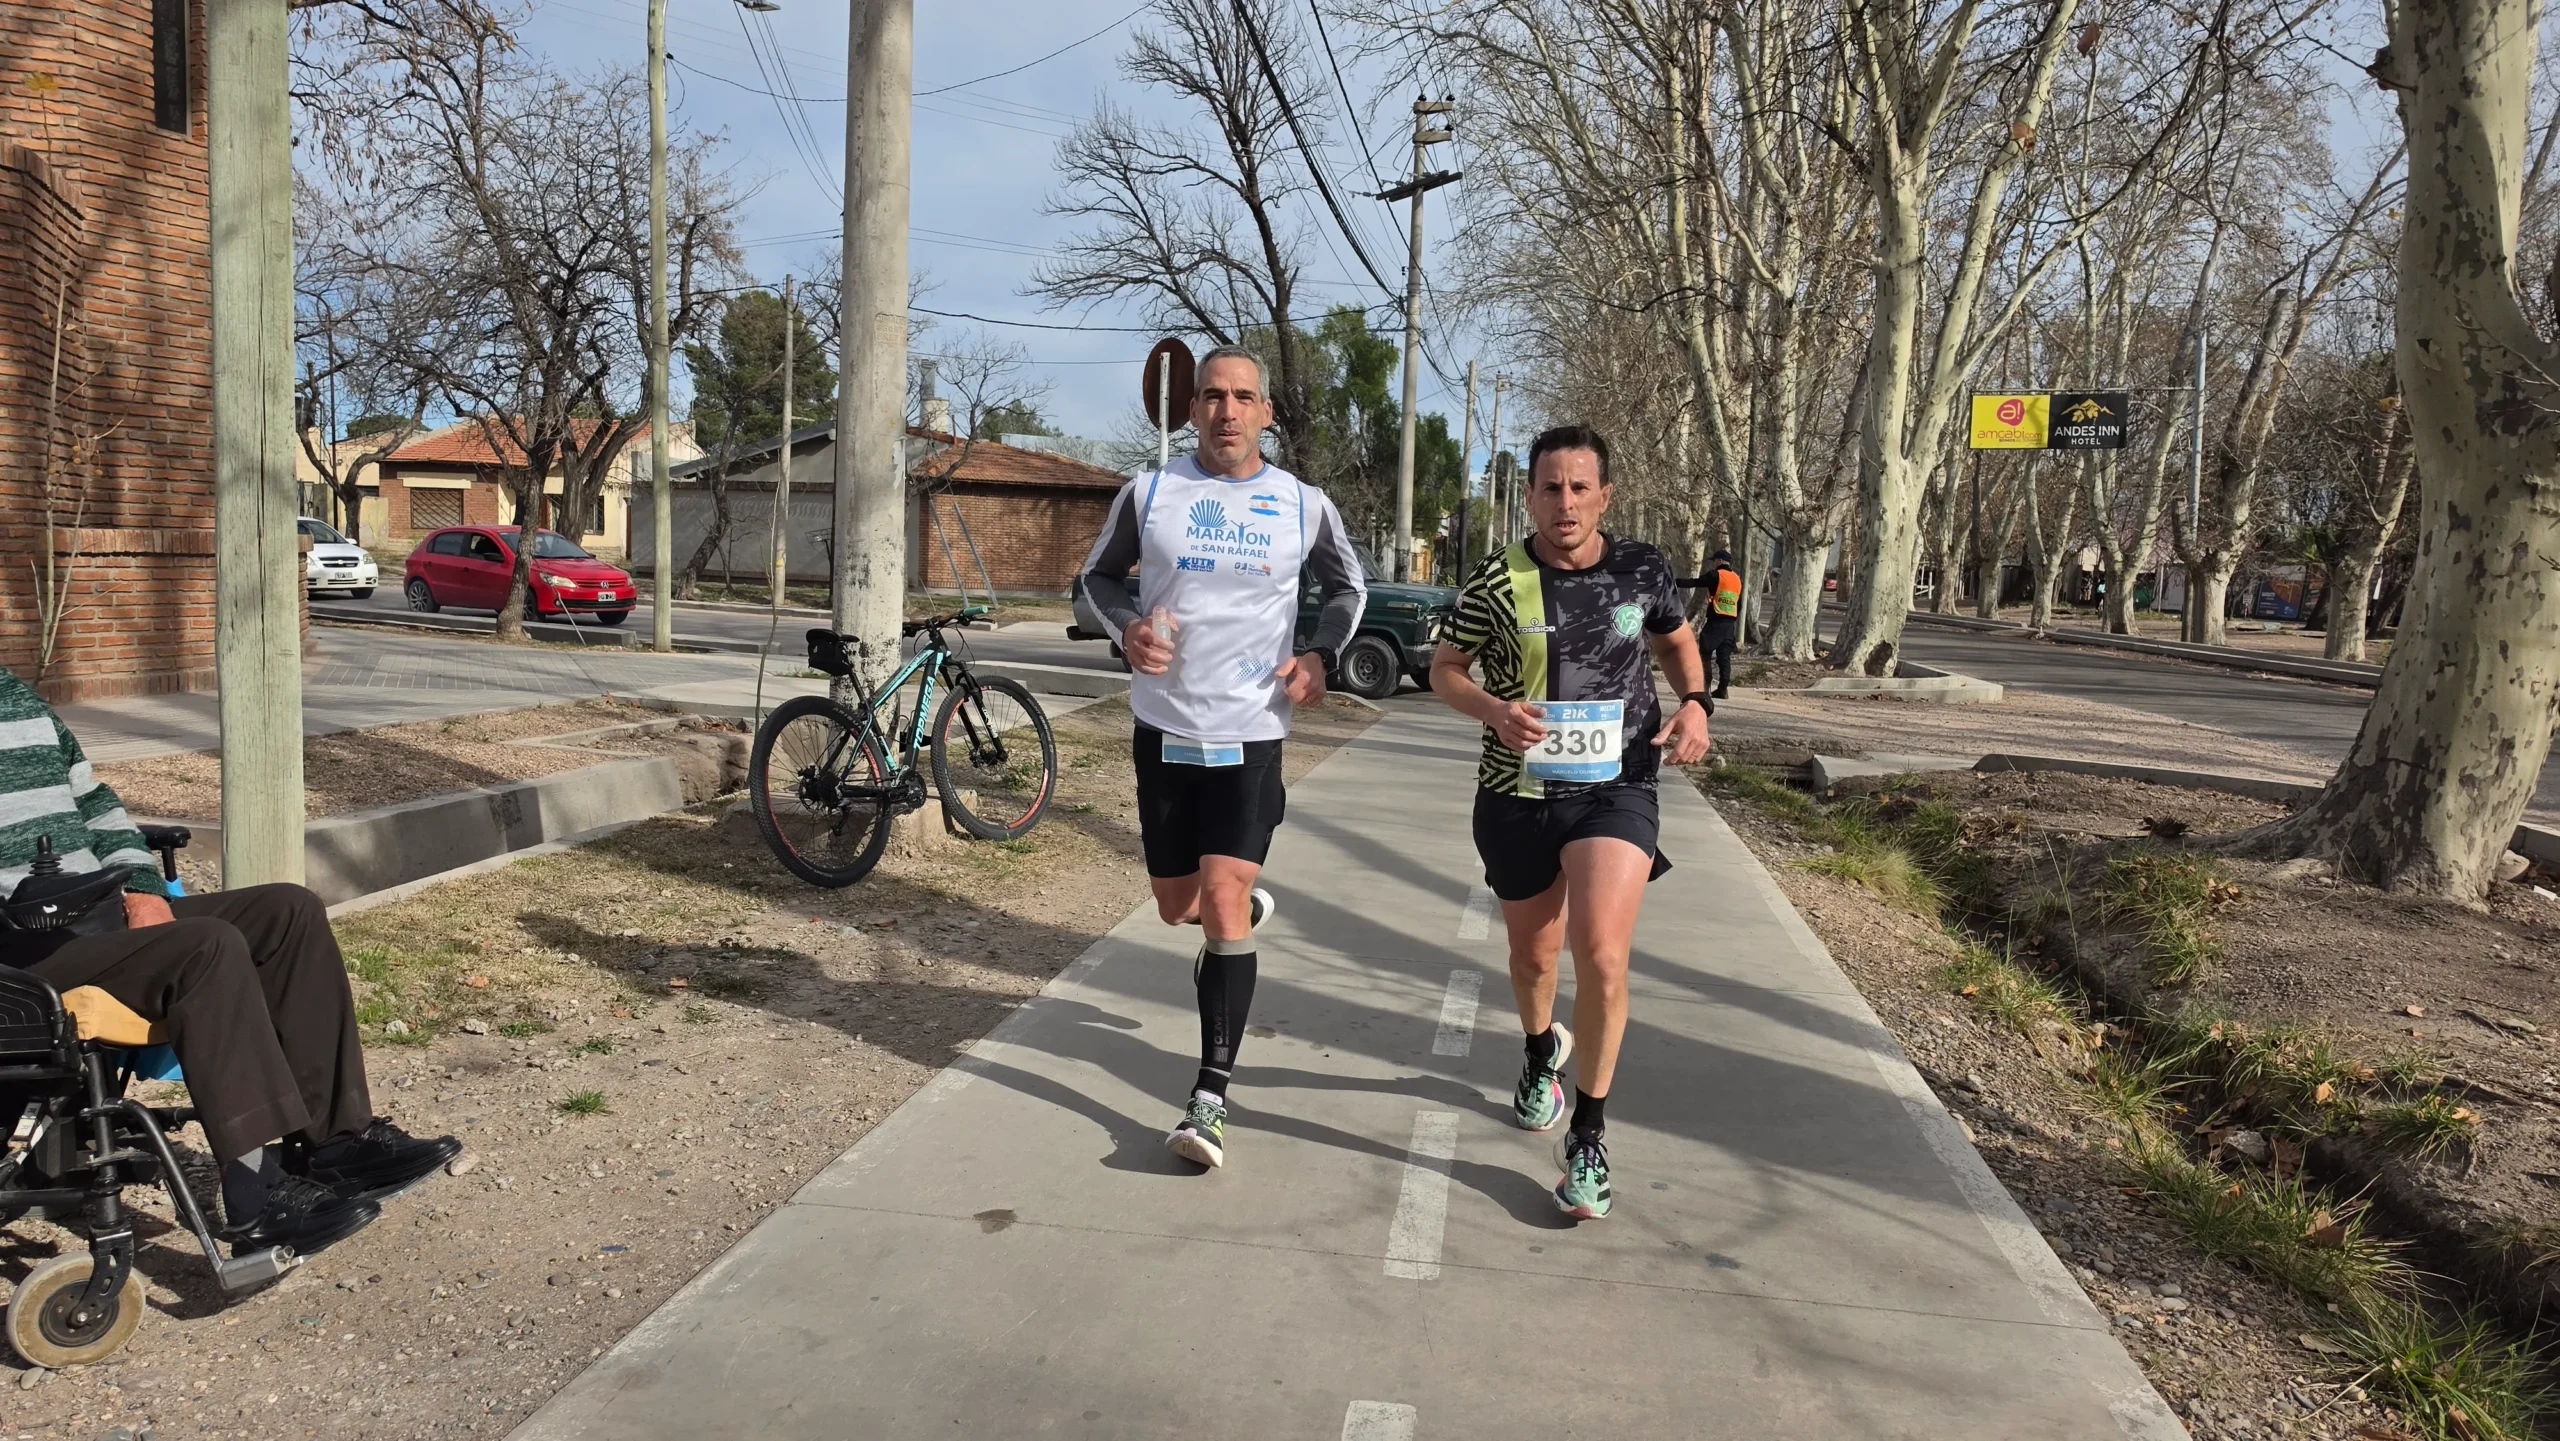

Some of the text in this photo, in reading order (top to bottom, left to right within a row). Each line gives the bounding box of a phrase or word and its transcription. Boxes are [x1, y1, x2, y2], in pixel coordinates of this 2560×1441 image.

[1977, 427, 2043, 439] amcabi.com
[2054, 425, 2120, 437] ANDES INN
[2071, 437, 2101, 445] HOTEL
[1185, 525, 1271, 547] MARATON
[1201, 543, 1225, 554] SAN
[1227, 546, 1269, 559] RAFAEL
[1191, 557, 1216, 567] UTN
[1516, 625, 1556, 634] TOSSICO
[913, 676, 936, 750] TOPMEGA
[1561, 707, 1590, 719] 21K
[1543, 728, 1607, 756] 330
